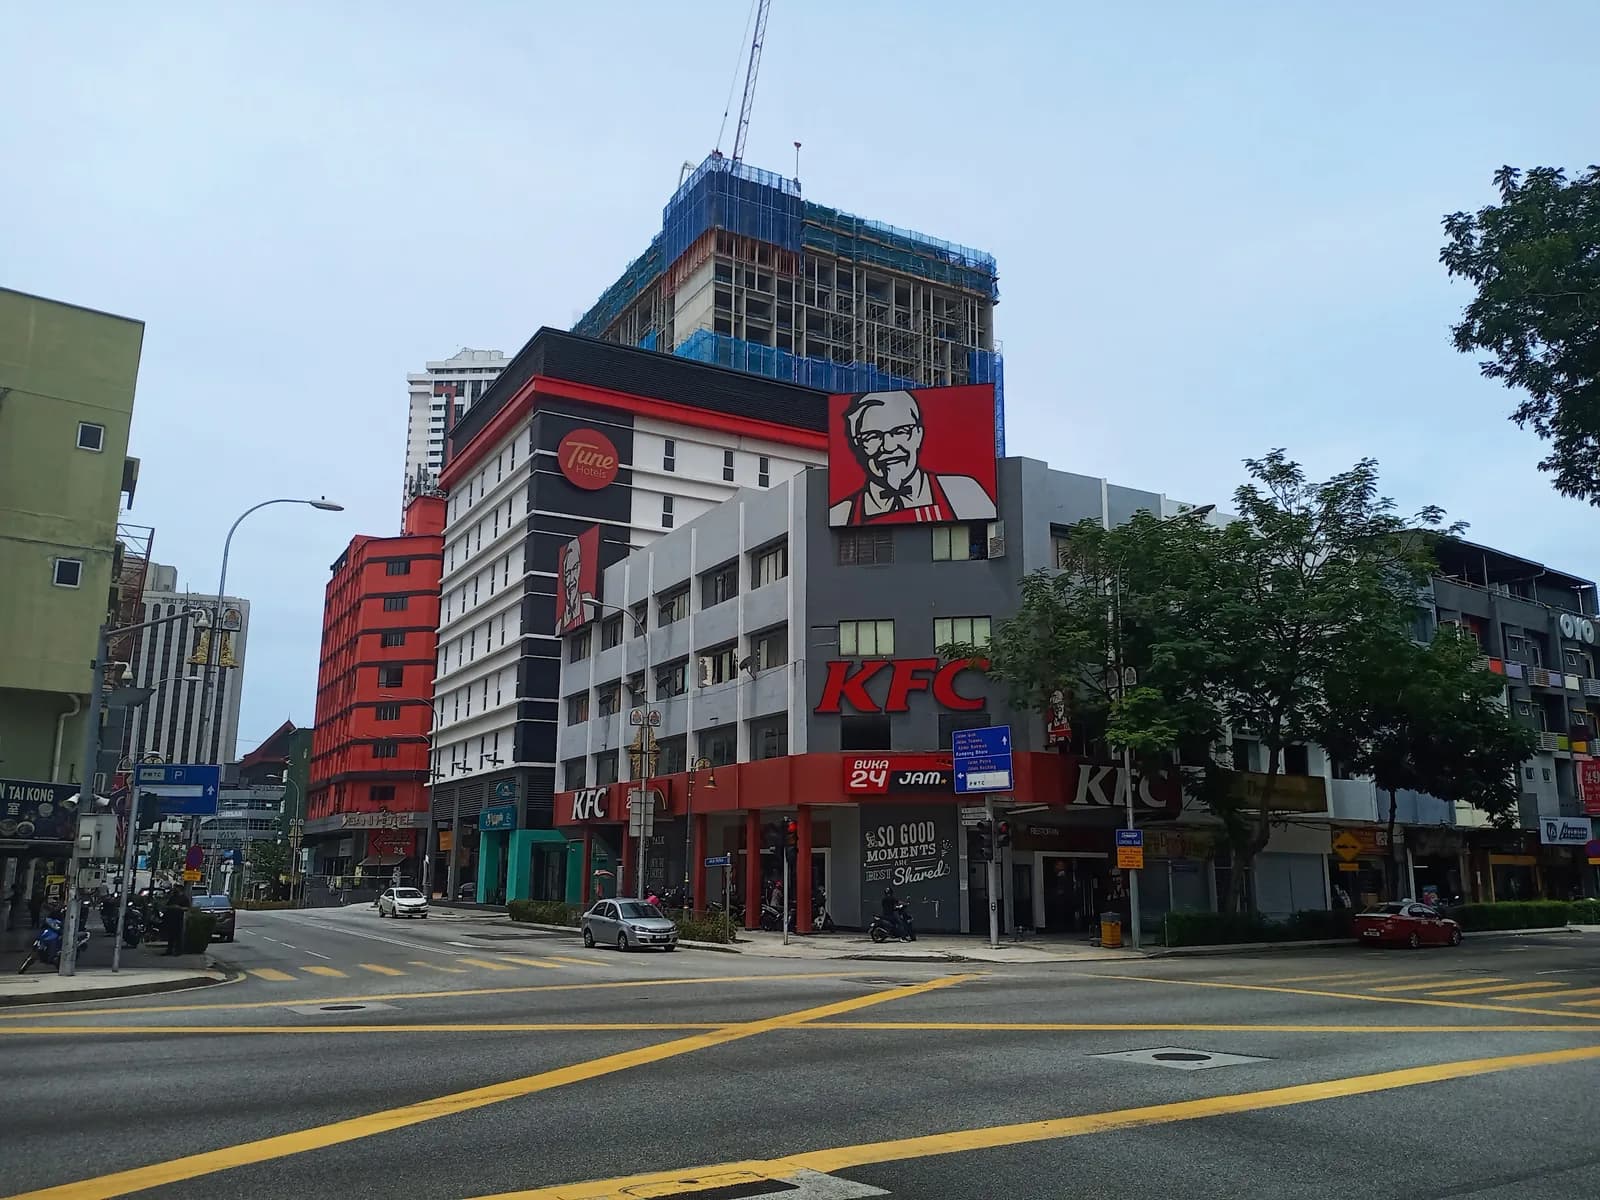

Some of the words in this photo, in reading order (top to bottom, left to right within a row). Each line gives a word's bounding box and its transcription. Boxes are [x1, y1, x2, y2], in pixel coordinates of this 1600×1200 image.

[566, 441, 614, 469] Tune
[575, 463, 608, 479] Hotels
[1560, 613, 1595, 644] OYO
[814, 658, 991, 714] KFC
[854, 759, 889, 769] BUKA
[849, 770, 887, 788] 24
[898, 771, 941, 785] JAM
[1072, 764, 1169, 808] KFC
[9, 785, 25, 800] TAI
[26, 786, 54, 802] KONG
[571, 787, 608, 820] KFC
[877, 825, 895, 847] SO
[900, 821, 935, 845] GOOD
[866, 843, 936, 862] MOMENTS
[865, 868, 892, 881] BEST
[893, 859, 947, 886] Shared
